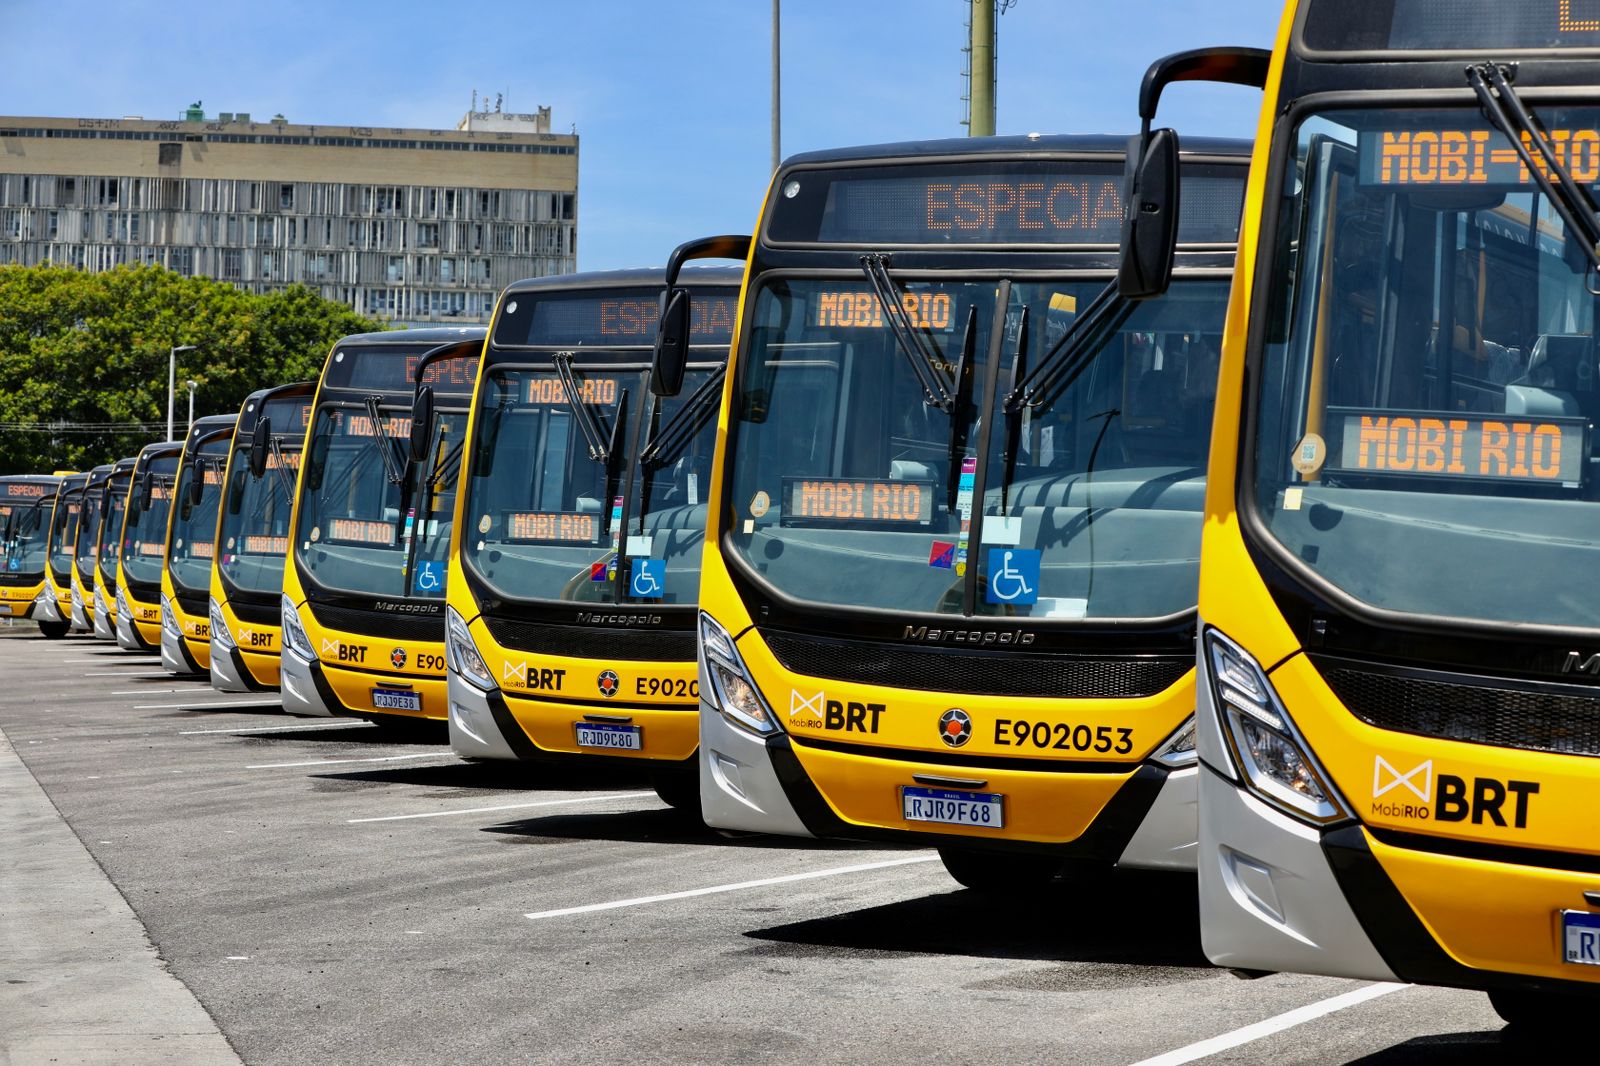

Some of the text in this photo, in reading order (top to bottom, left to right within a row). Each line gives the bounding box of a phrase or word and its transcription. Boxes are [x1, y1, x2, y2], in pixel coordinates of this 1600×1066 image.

[1381, 129, 1600, 184] MOBI-RIO
[819, 292, 949, 328] MOBI-RIO
[529, 379, 615, 404] MOB-RIO
[1358, 416, 1562, 478] MOBI RIO
[8, 485, 46, 496] ESPECIAL
[801, 481, 920, 520] MOBI RIO
[334, 519, 391, 544] MOBI RIO
[514, 513, 592, 540] MOBI RIO
[143, 609, 158, 619] BRT
[375, 602, 439, 613] Marcopolo
[576, 612, 661, 626] Marcopolo
[251, 633, 273, 647] BRT
[903, 625, 1036, 645] Marcopolo
[338, 644, 368, 663] BRT
[417, 654, 447, 671] E90
[526, 667, 566, 691] BRT
[788, 717, 823, 729] MobiRIO
[824, 700, 886, 734] BRT
[582, 731, 633, 748] RJD9C80
[994, 719, 1134, 754] E902053
[912, 798, 991, 823] RJR9F68
[1371, 803, 1430, 820] MobiRIO
[1434, 774, 1540, 829] BRT
